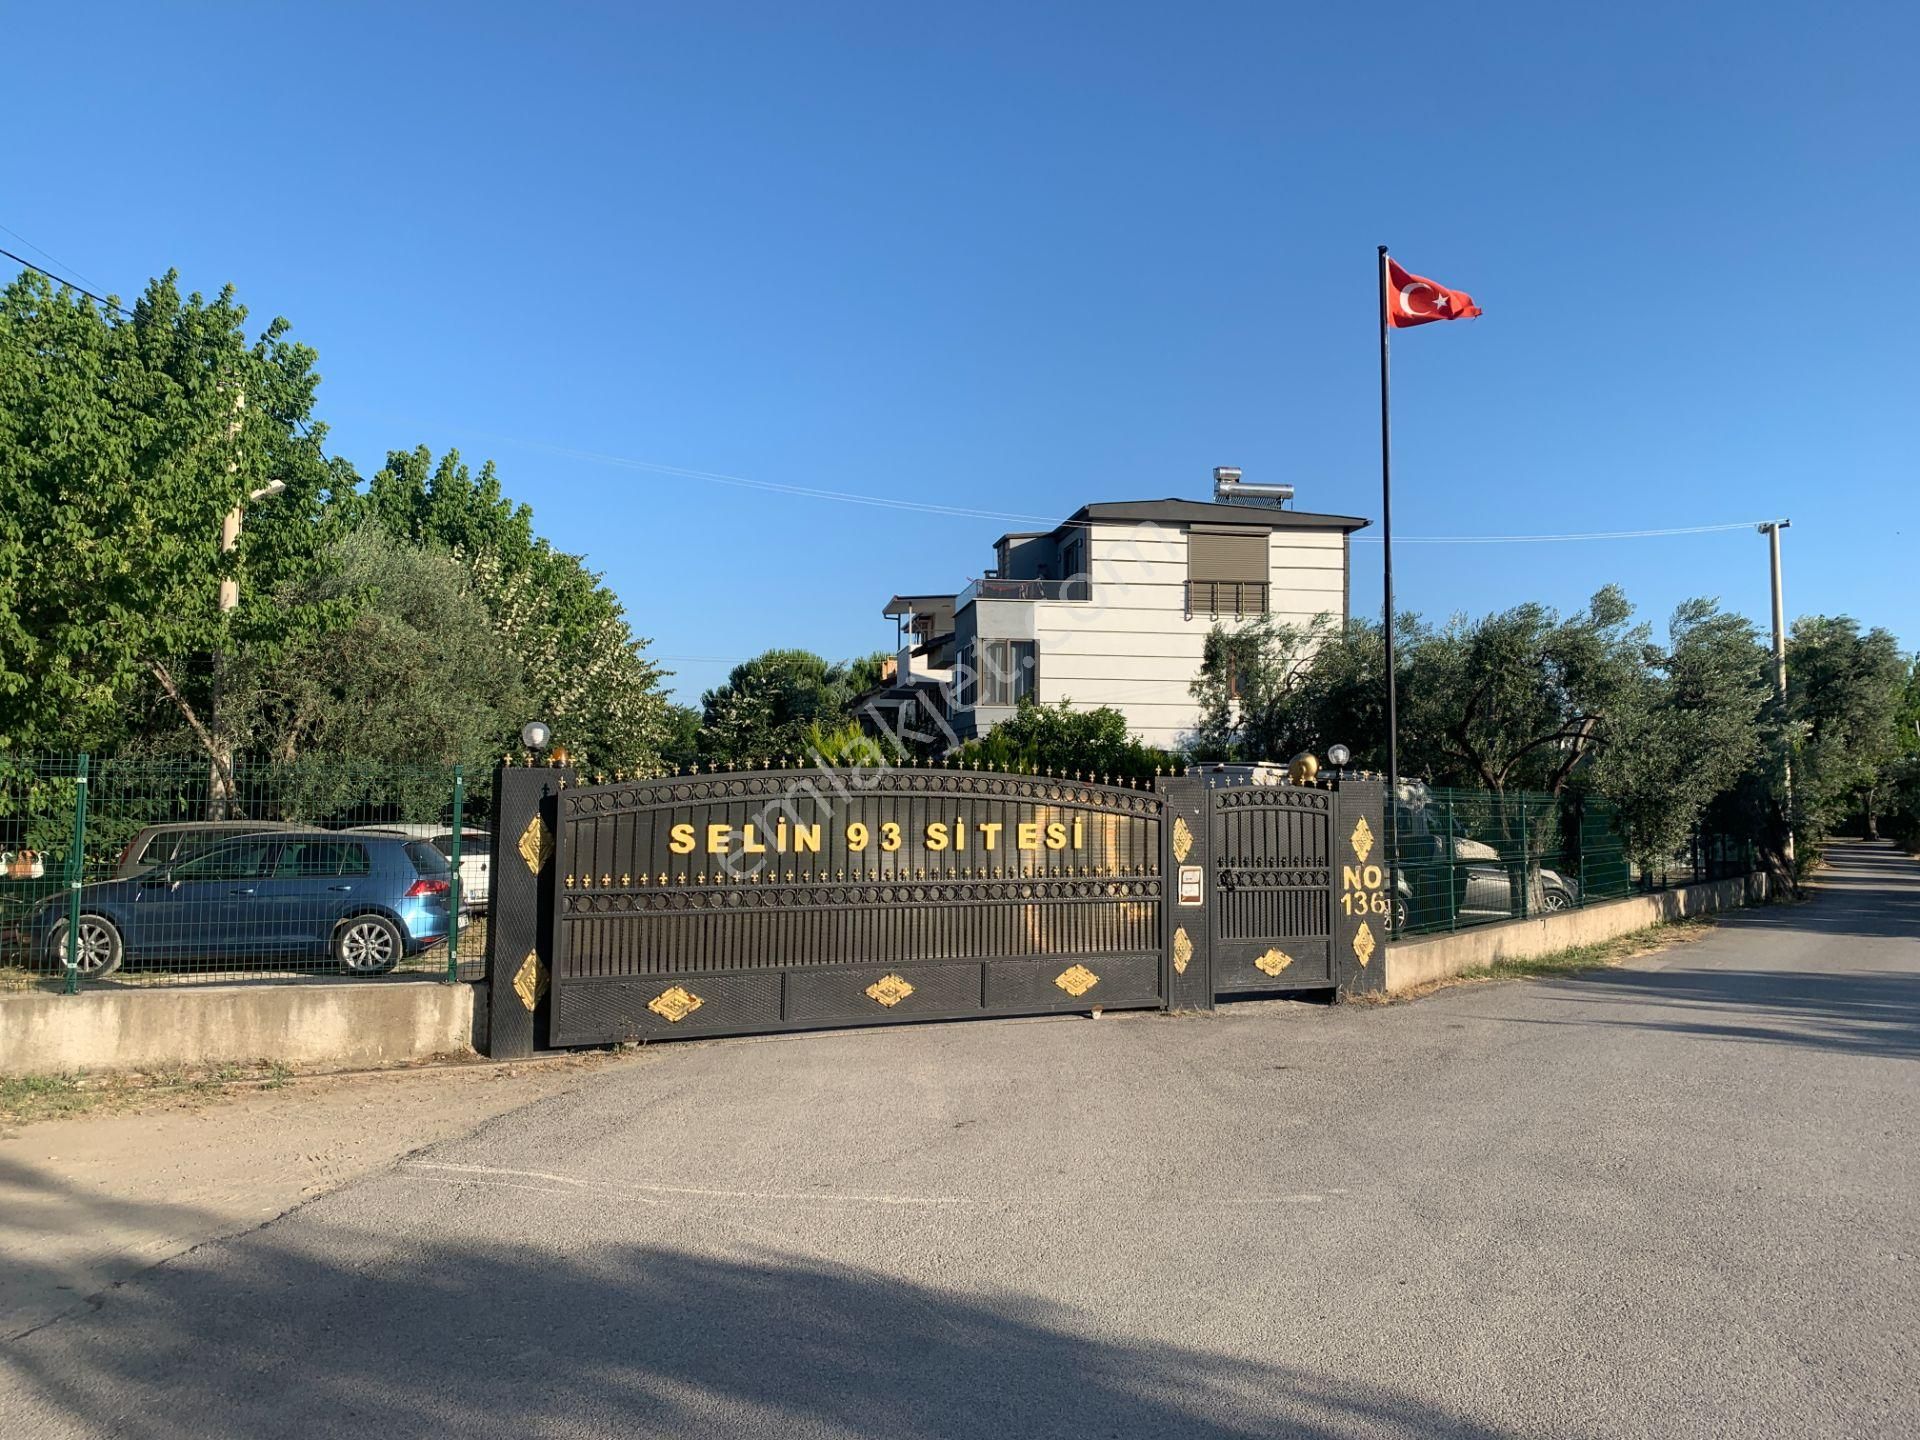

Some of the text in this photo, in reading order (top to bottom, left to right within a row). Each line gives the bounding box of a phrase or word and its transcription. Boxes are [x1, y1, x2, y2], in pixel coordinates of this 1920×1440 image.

[669, 816, 1083, 854] SELİN 93 SİTESİ
[1343, 866, 1382, 890] NO
[1341, 891, 1385, 916] 136
